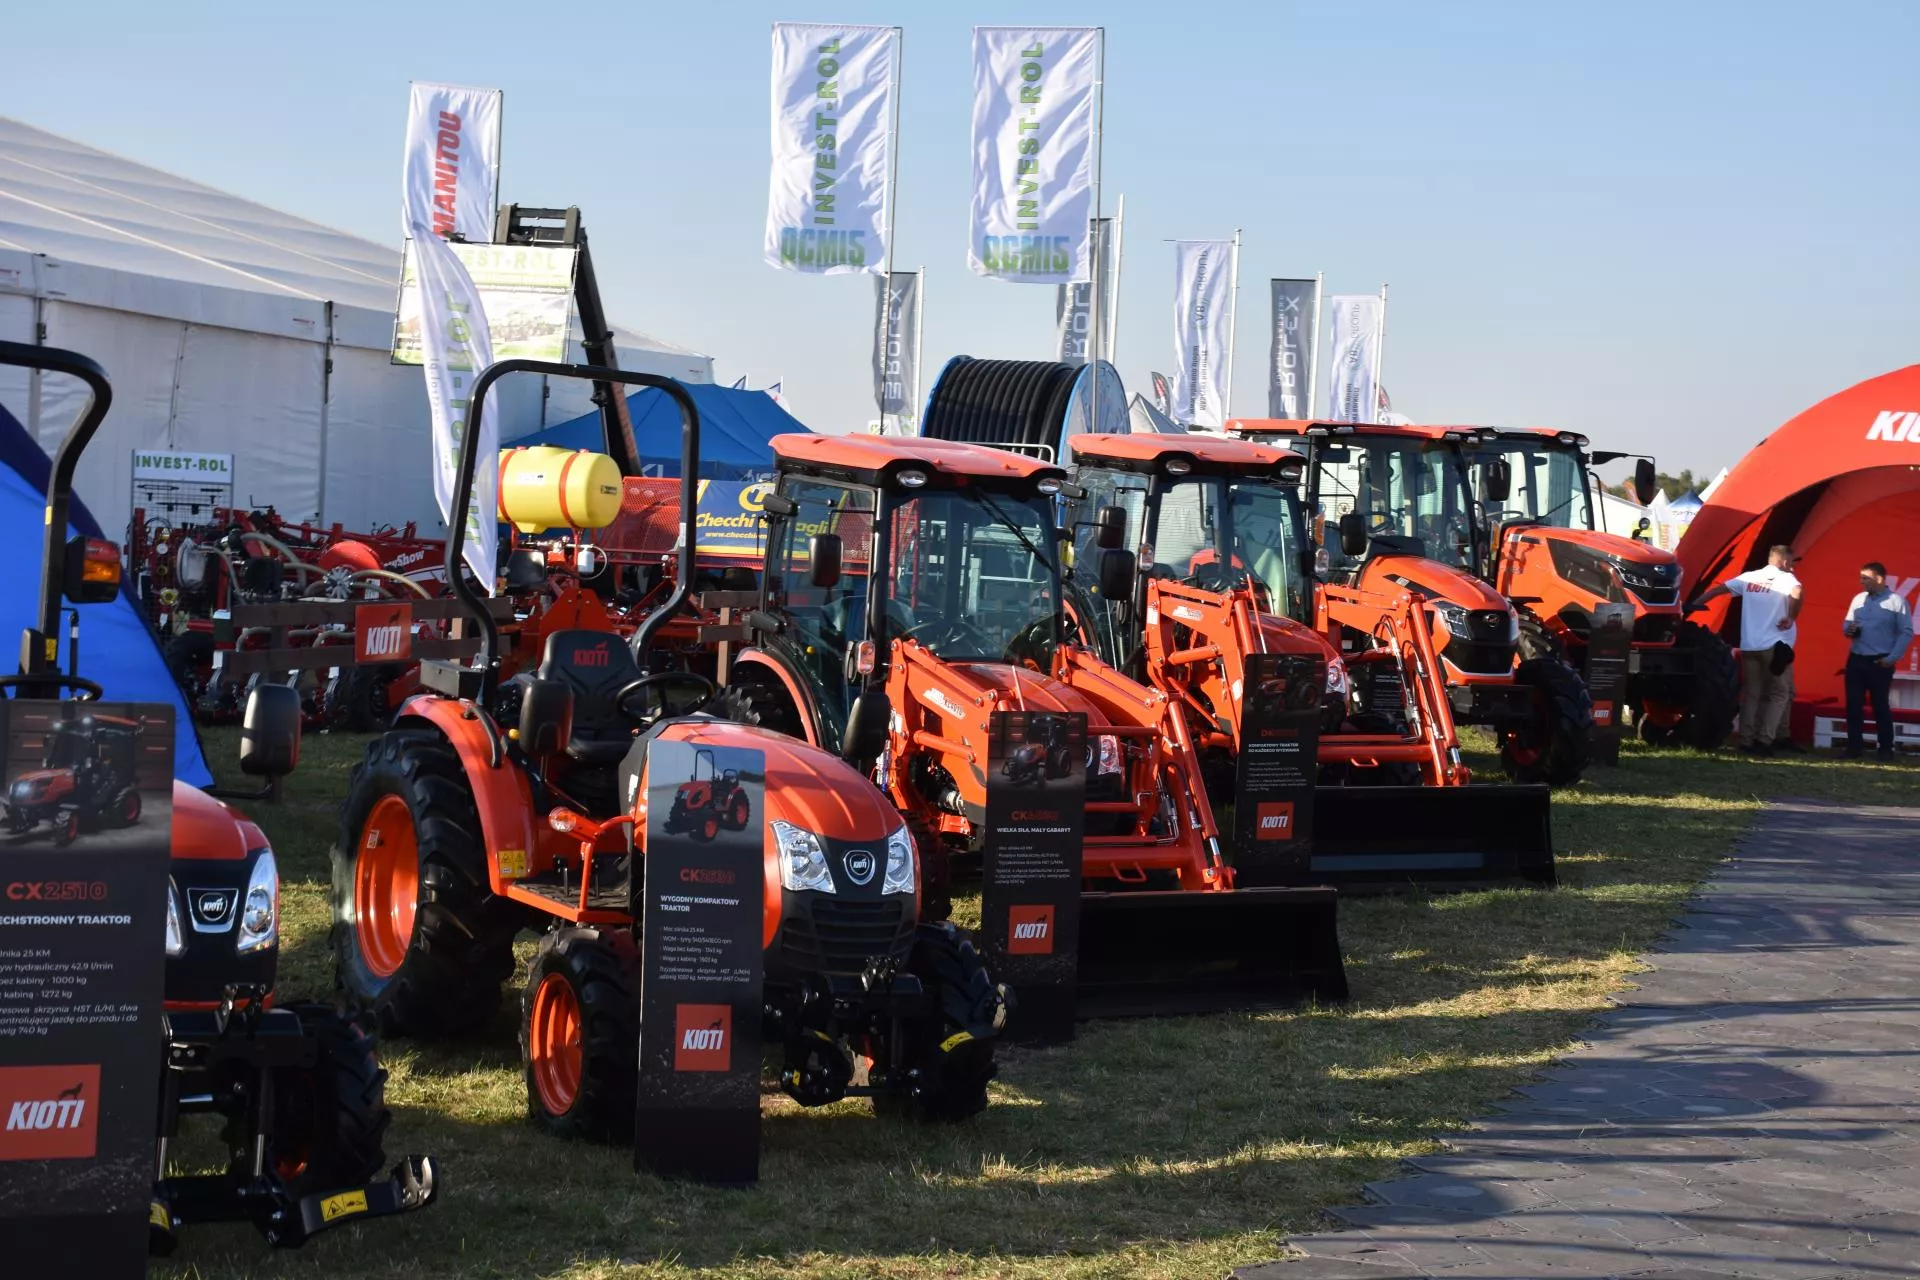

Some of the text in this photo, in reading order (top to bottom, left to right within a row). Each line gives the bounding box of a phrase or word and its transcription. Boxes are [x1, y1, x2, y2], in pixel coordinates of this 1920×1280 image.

[814, 38, 841, 225] INVEST-ROL
[1016, 42, 1043, 231] INVEST-ROL
[432, 110, 462, 238] MANITOU
[135, 456, 228, 472] INVEST-ROL
[695, 512, 757, 528] Checchi
[365, 625, 402, 655] KIOTI
[1261, 815, 1289, 829] KIOTI
[6, 882, 108, 901] CX2510
[203, 901, 224, 912] KIOTI
[660, 895, 740, 905] WYGODNY KOMPAKTOWY
[660, 904, 690, 912] TRAKTOR
[76, 915, 132, 925] TRAKTOR
[1014, 923, 1048, 939] KIOTI
[23, 949, 34, 958] 25
[36, 949, 51, 957] KM
[15, 962, 70, 973] hydrauliczny
[16, 976, 46, 986] kabiny
[52, 976, 75, 984] 1000
[76, 976, 87, 985] kg
[41, 989, 60, 998] 1272
[62, 989, 73, 999] kg
[34, 1005, 70, 1014] skrzynia
[73, 1004, 91, 1012] HST
[119, 1003, 138, 1012] dwa
[76, 1014, 88, 1023] do
[89, 1014, 120, 1025] przodu
[126, 1013, 138, 1022] do
[37, 1026, 48, 1036] kg
[683, 1029, 724, 1050] KIOTI
[6, 1099, 85, 1131] KIOTI
